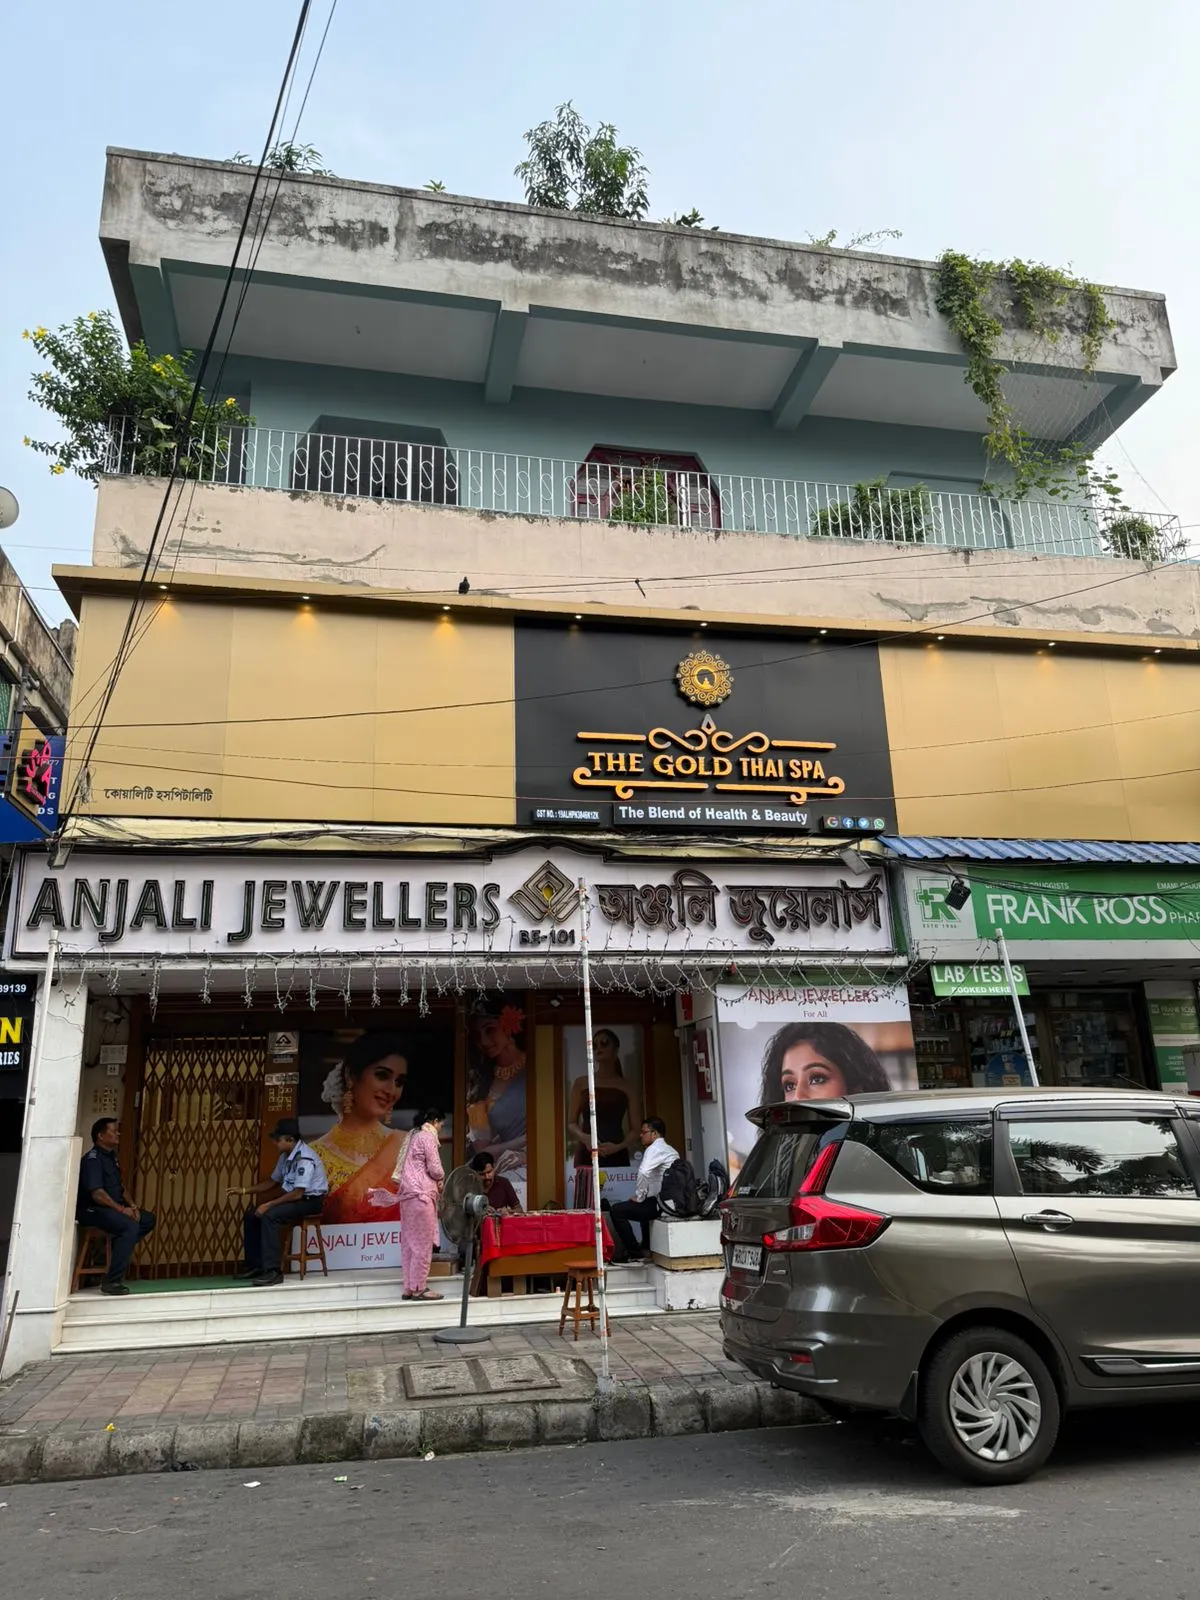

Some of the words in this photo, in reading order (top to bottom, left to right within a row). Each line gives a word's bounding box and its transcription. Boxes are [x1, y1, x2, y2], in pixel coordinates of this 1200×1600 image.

[587, 751, 645, 773] THE
[653, 754, 733, 777] GOLD
[739, 757, 784, 779] THAI
[790, 759, 826, 780] SPA
[536, 809, 546, 818] GST
[619, 806, 645, 819] The
[650, 807, 686, 820] Blend
[688, 808, 701, 820] of
[705, 808, 748, 821] Health
[751, 810, 761, 821] &
[765, 810, 808, 826] Beauty
[26, 877, 215, 943] ANJALI
[227, 879, 501, 943] JEWELLERS
[593, 868, 721, 931] অঞ্জলি
[725, 873, 884, 946] জুয়েলার্স
[986, 892, 1088, 925] FRANK
[1092, 895, 1167, 925] ROSS
[933, 965, 965, 982] LAB
[969, 965, 1024, 982] TESTS
[748, 987, 797, 1004] ANJALI
[801, 987, 879, 1004] JEWELLERS
[816, 1010, 828, 1018] All
[307, 1233, 357, 1251] ANJALI
[361, 1254, 373, 1262] For
[374, 1253, 385, 1261] All
